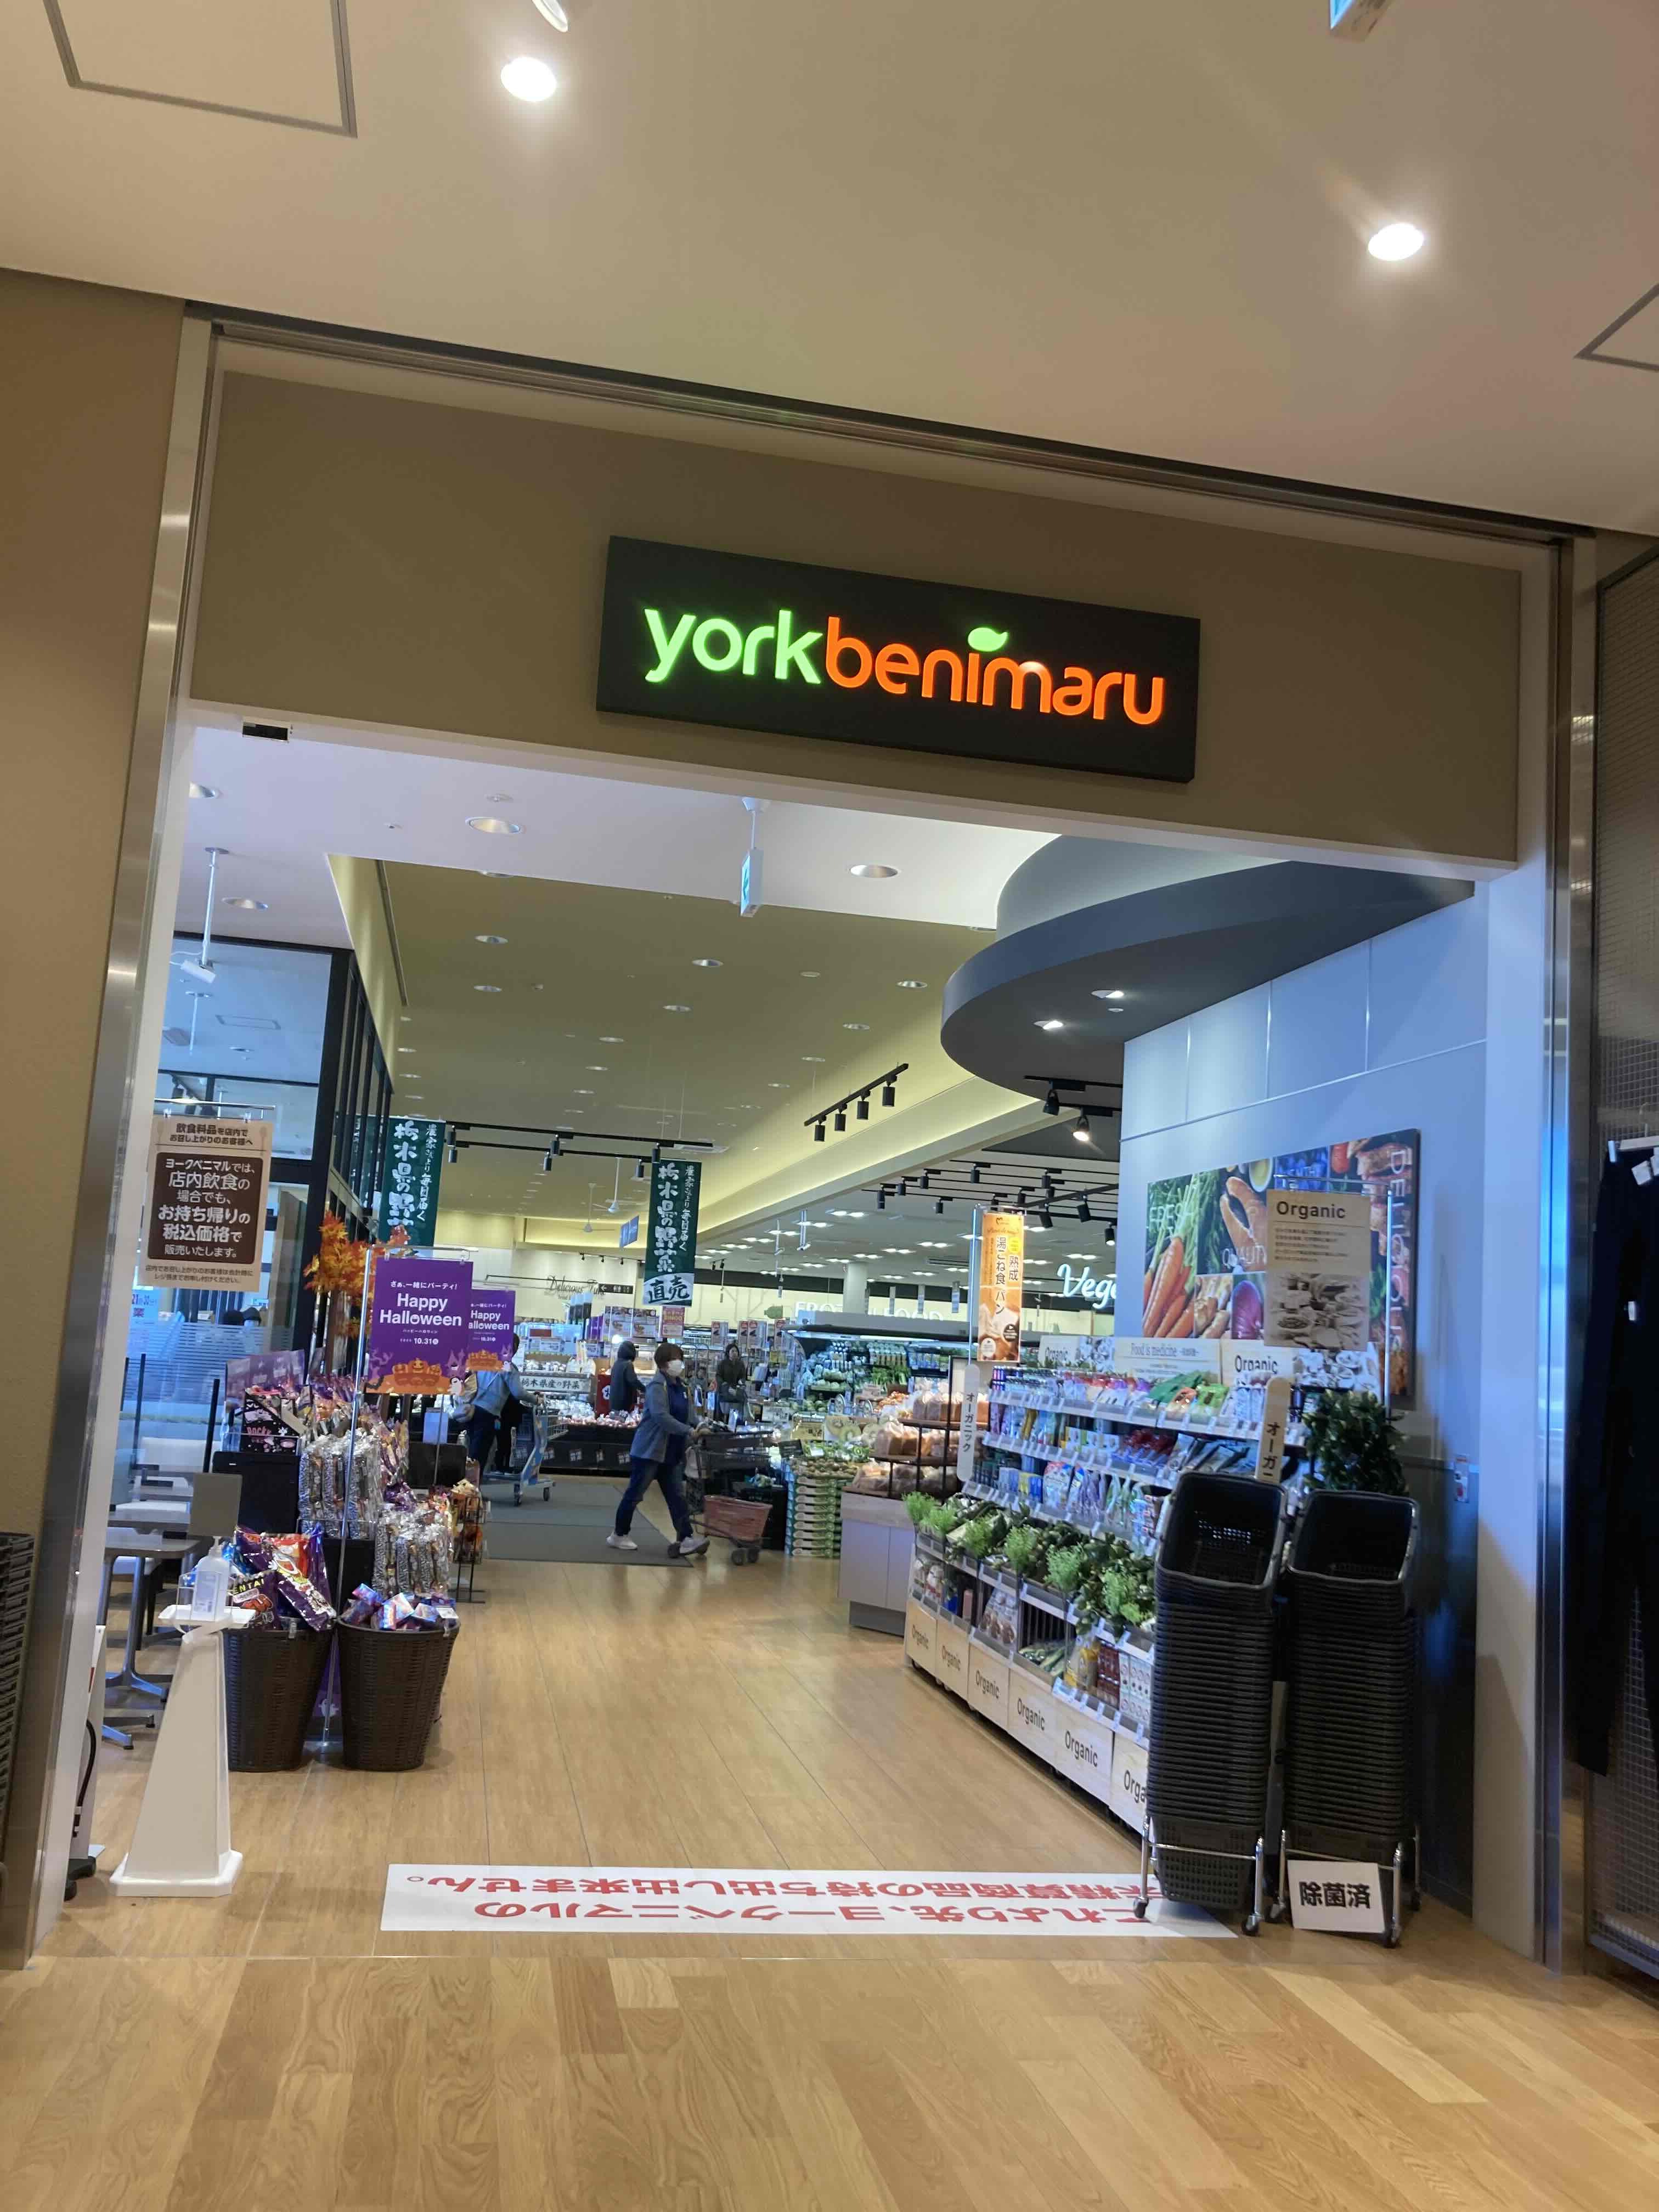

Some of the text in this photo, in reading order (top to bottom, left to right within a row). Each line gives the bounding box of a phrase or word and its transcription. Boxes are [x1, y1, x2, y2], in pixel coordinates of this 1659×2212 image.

[165, 1158, 256, 1174] ヨークベニマルでは、
[168, 1171, 250, 1191] 店内飲食の
[177, 1190, 232, 1204] 場合でも、
[157, 1204, 251, 1224] お持ち帰りの
[1276, 1200, 1346, 1220] Organic
[162, 1223, 242, 1243] 税込価格で
[164, 1244, 238, 1259] 販売いたします。
[648, 1275, 690, 1304] 直売
[1057, 1263, 1117, 1309] Veg
[397, 1293, 448, 1312] Happy
[380, 1309, 462, 1327] Halloween
[468, 1320, 510, 1330] alloween
[471, 1310, 501, 1322] Happy
[962, 1393, 975, 1453] オーガニック
[941, 1645, 961, 1672] Organic
[975, 1669, 1000, 1700] Organic
[1017, 1698, 1046, 1731] Organic
[1064, 1729, 1098, 1768] Organic
[1123, 1769, 1146, 1804] Orga
[1298, 1881, 1371, 1910] 除菌済
